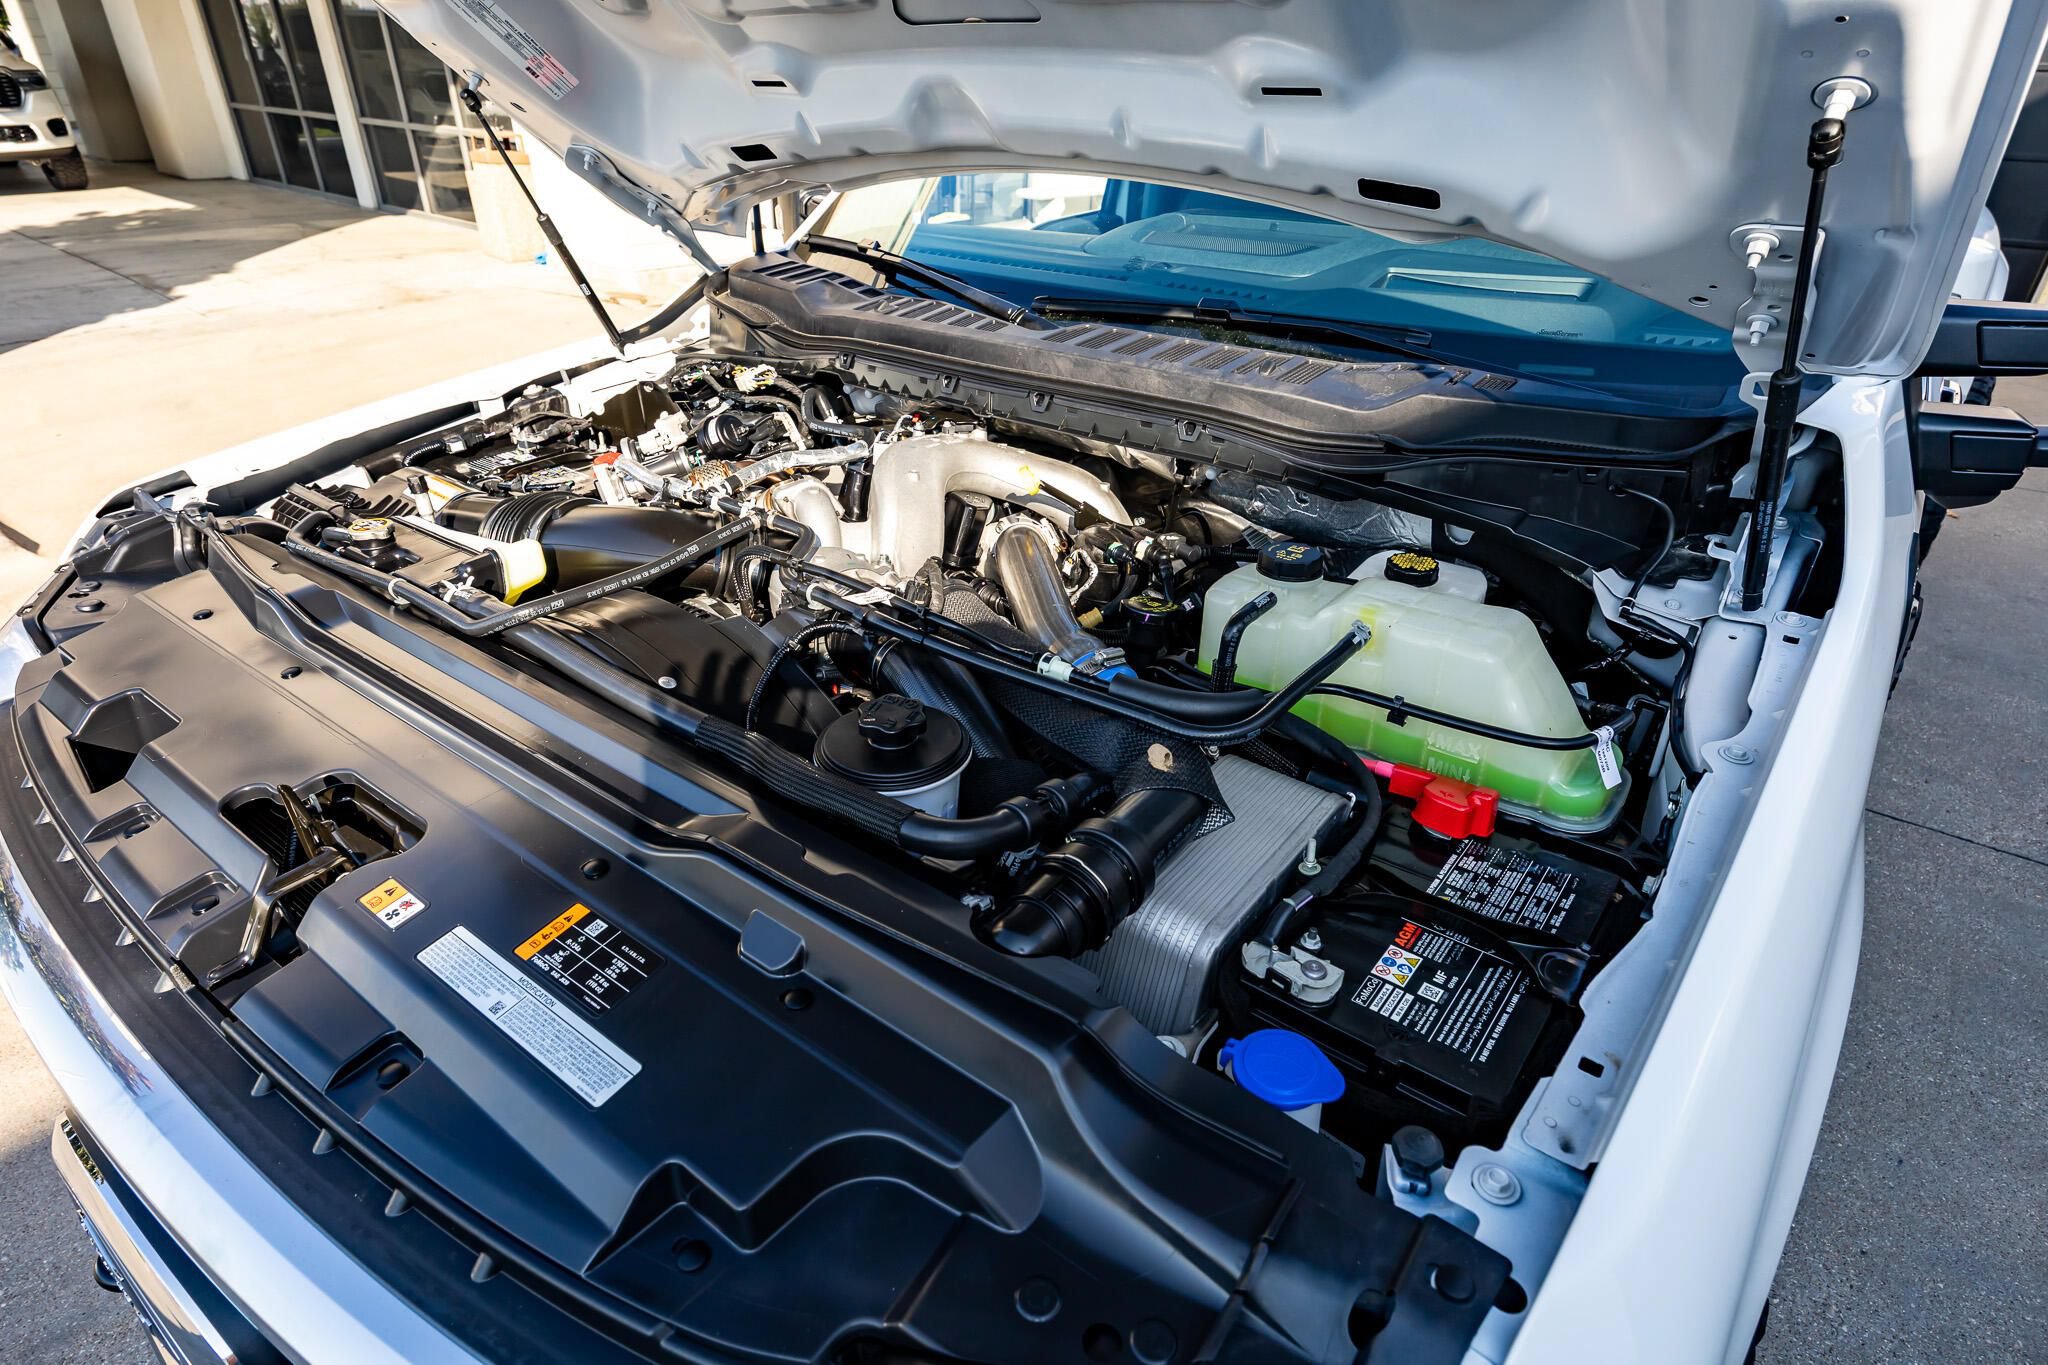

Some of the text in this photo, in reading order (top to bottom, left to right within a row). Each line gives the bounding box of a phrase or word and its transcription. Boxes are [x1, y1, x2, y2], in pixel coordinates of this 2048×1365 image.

[1435, 733, 1481, 761] MAX
[1426, 756, 1463, 781] MIN
[1393, 921, 1417, 947] AGM
[564, 938, 583, 952] R-134a
[530, 955, 551, 971] FoMoCo
[550, 952, 564, 962] PAG
[584, 979, 604, 994] (110 cc)
[1432, 969, 1448, 984] MF
[516, 976, 557, 1008] MODIFICATION
[1355, 976, 1379, 1004] FoMoCo
